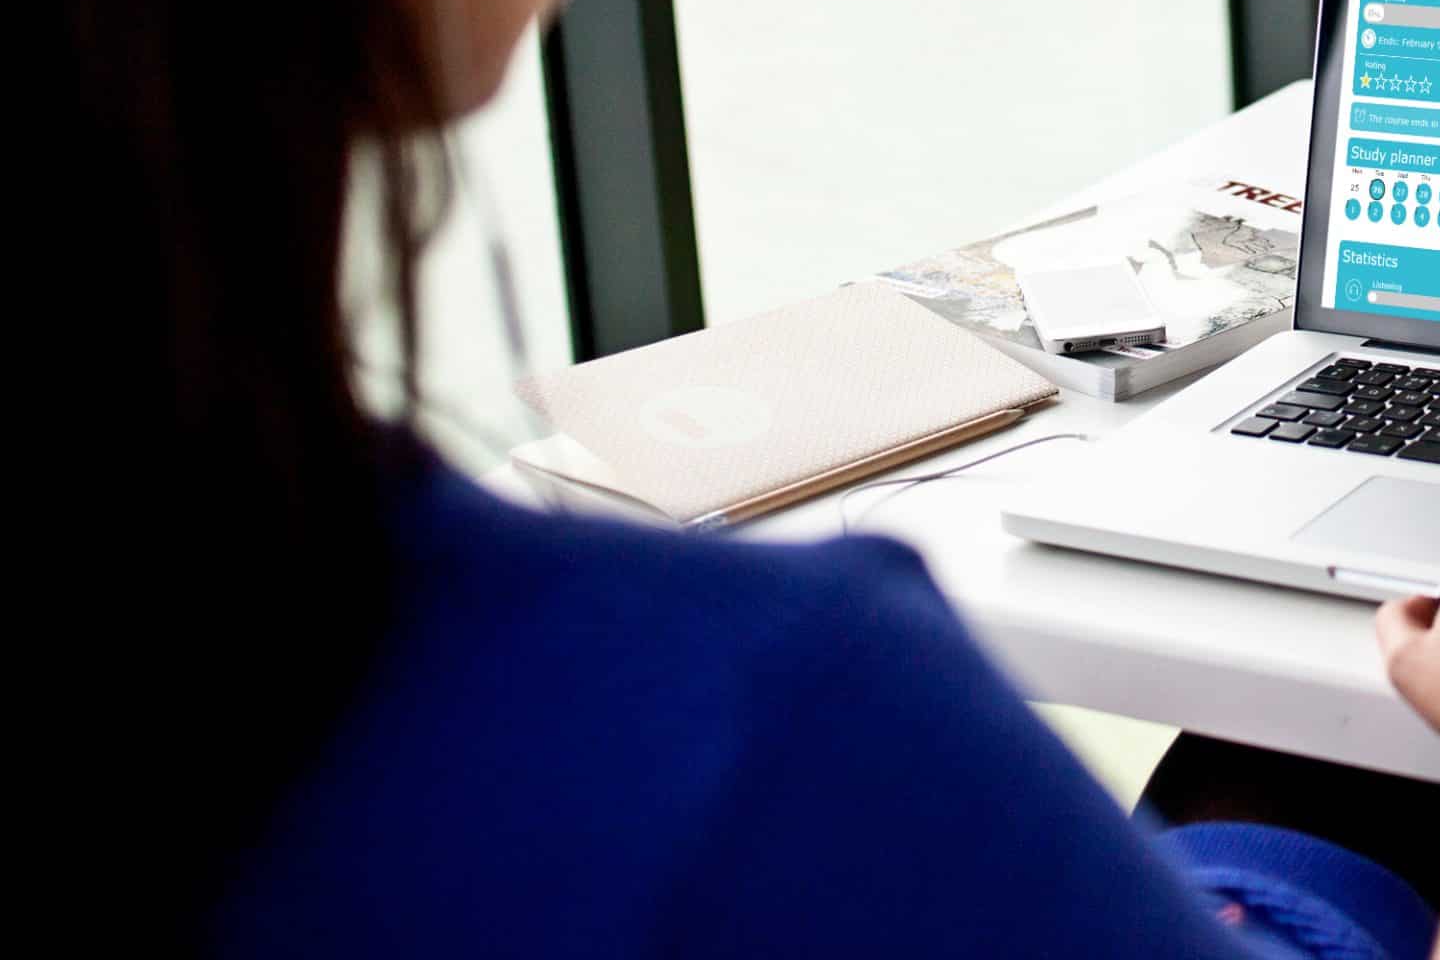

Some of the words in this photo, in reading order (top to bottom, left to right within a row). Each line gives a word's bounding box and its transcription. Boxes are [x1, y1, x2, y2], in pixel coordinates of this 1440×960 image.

[1351, 145, 1387, 165] Study
[1390, 149, 1438, 167] planner
[1343, 249, 1399, 269] Statistics
